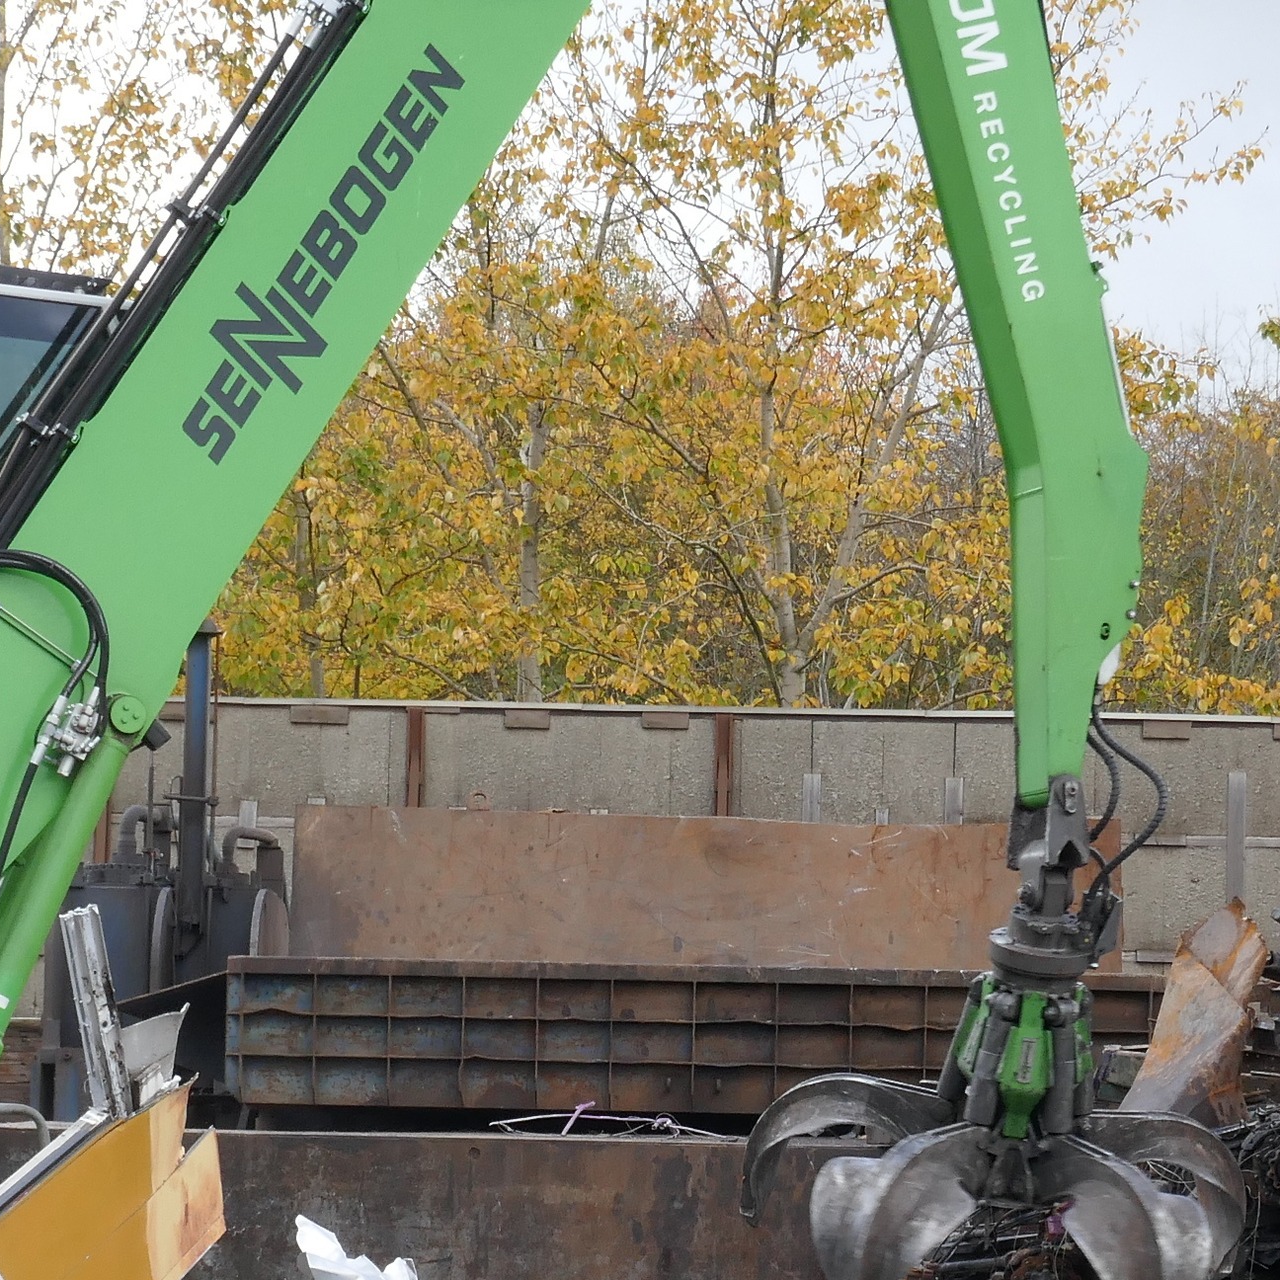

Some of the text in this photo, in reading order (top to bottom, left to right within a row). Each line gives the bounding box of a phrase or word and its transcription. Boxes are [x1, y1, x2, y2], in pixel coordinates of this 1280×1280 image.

[182, 43, 466, 466] SENNEBOGEN
[948, 0, 1045, 303] JM RECYCLING
